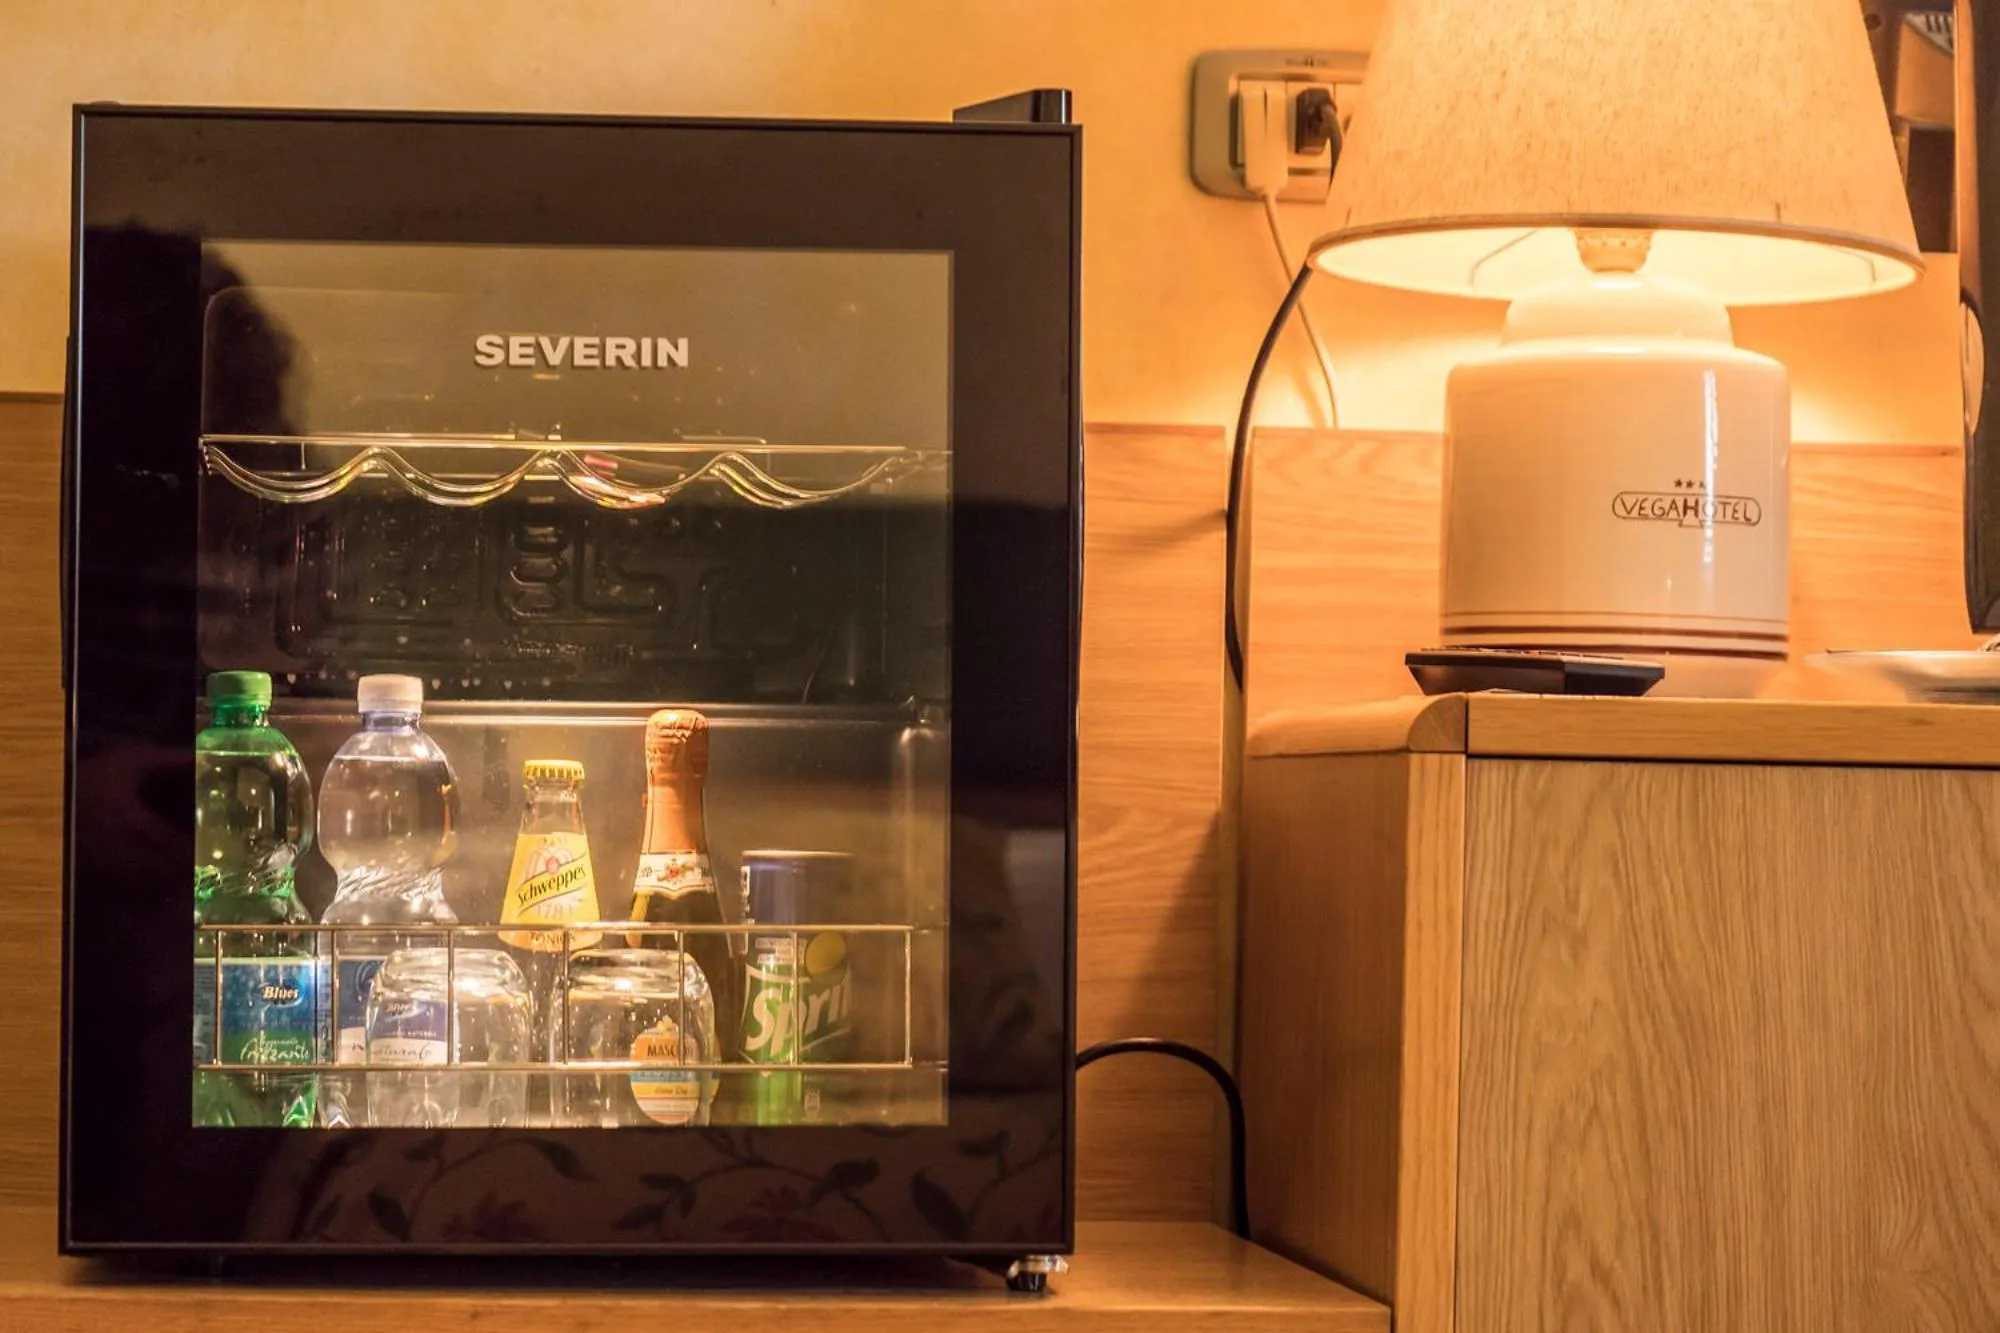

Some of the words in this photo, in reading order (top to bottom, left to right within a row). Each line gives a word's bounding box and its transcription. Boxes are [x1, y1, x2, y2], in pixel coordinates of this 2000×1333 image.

[474, 333, 689, 368] SEVERIN
[518, 863, 586, 905] Schweppes
[745, 965, 851, 1057] Sprit
